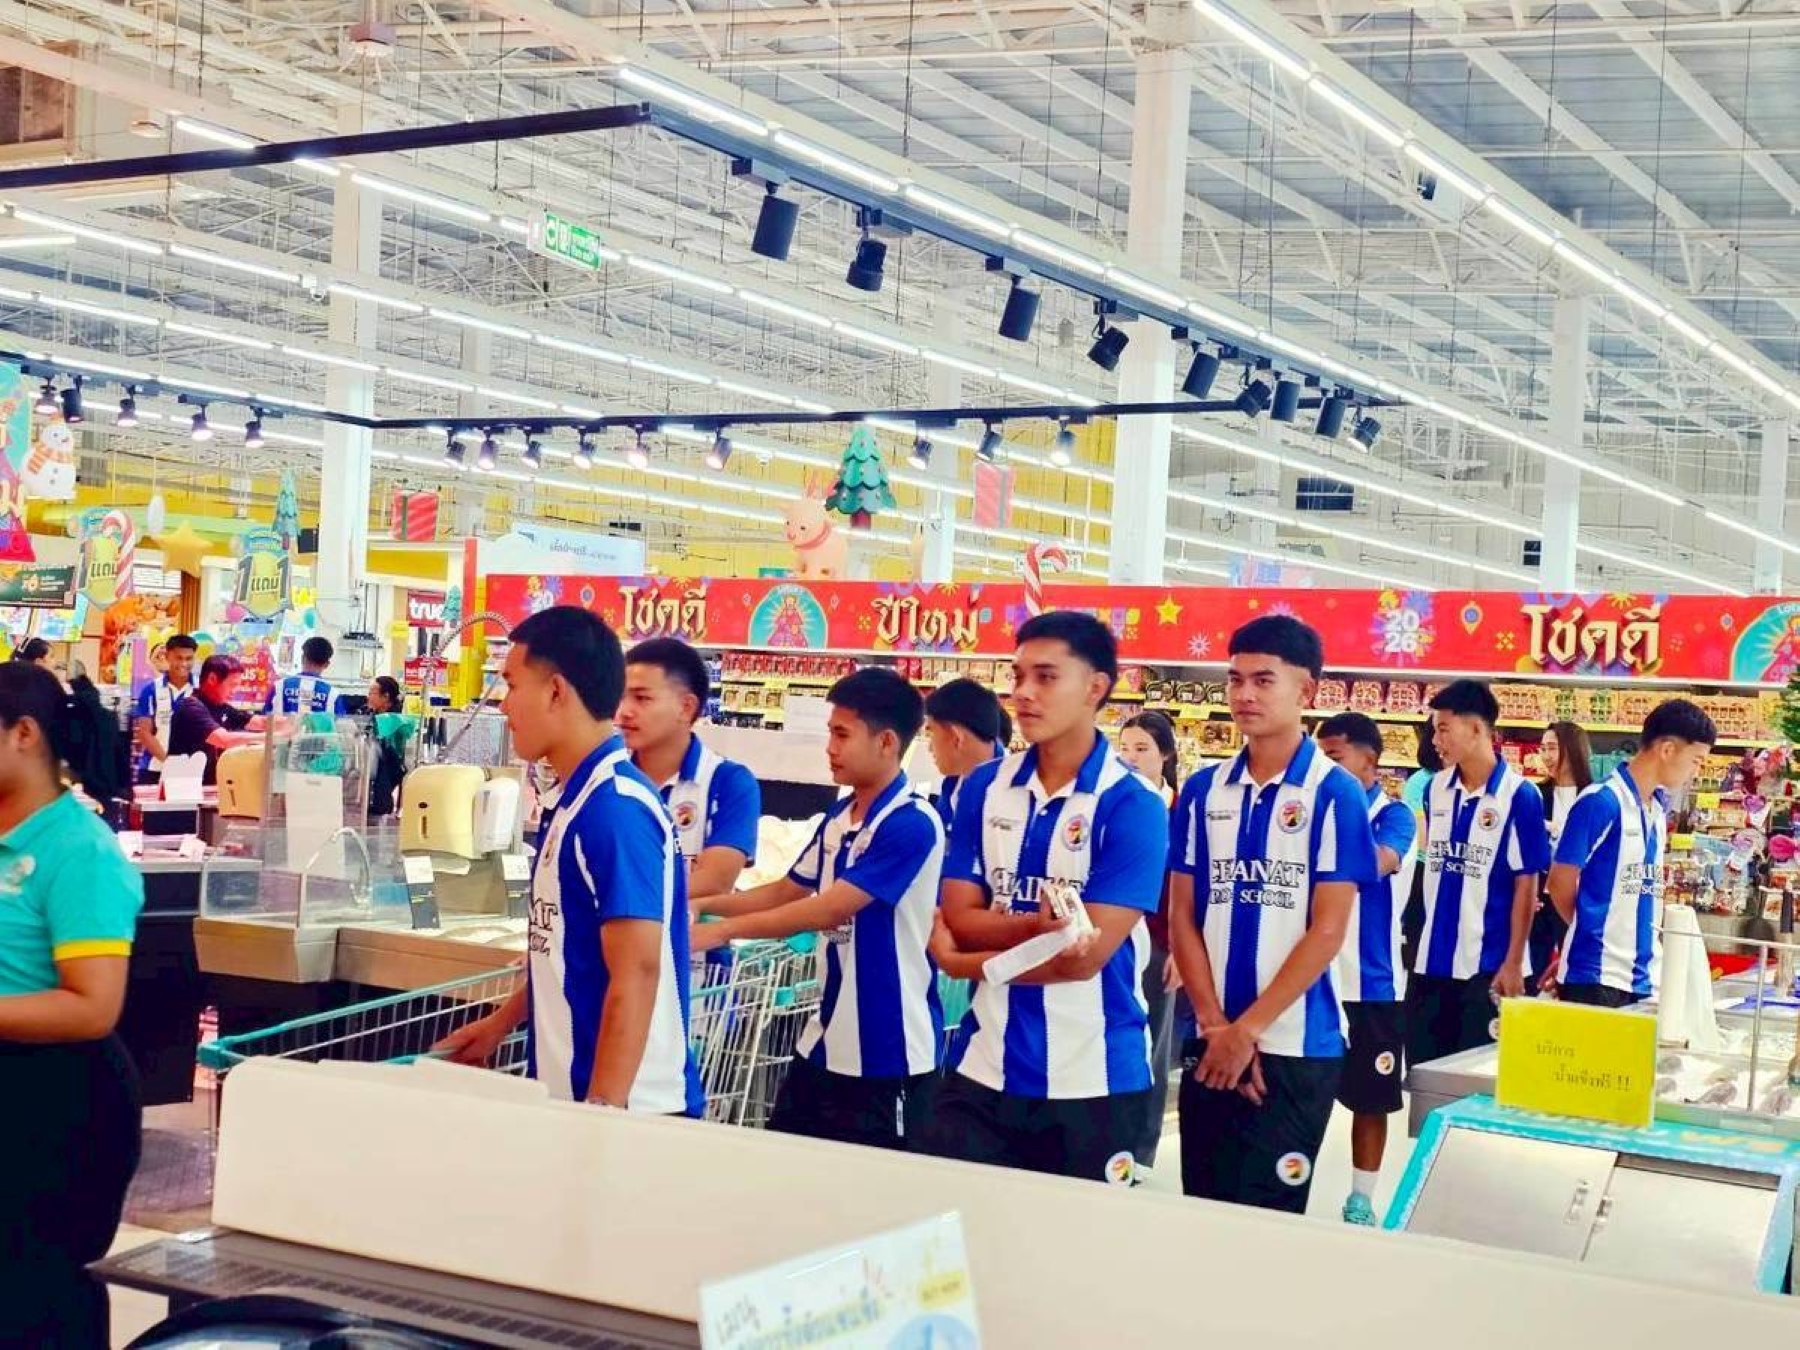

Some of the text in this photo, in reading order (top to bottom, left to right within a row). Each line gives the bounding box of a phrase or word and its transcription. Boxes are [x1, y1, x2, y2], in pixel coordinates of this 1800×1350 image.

[238, 556, 253, 601] 1
[618, 584, 708, 636] โชคดี
[870, 590, 980, 644] ปีใหม่
[1385, 609, 1420, 632] 20
[1385, 632, 1418, 653] 26
[1520, 602, 1662, 668] โชคดี
